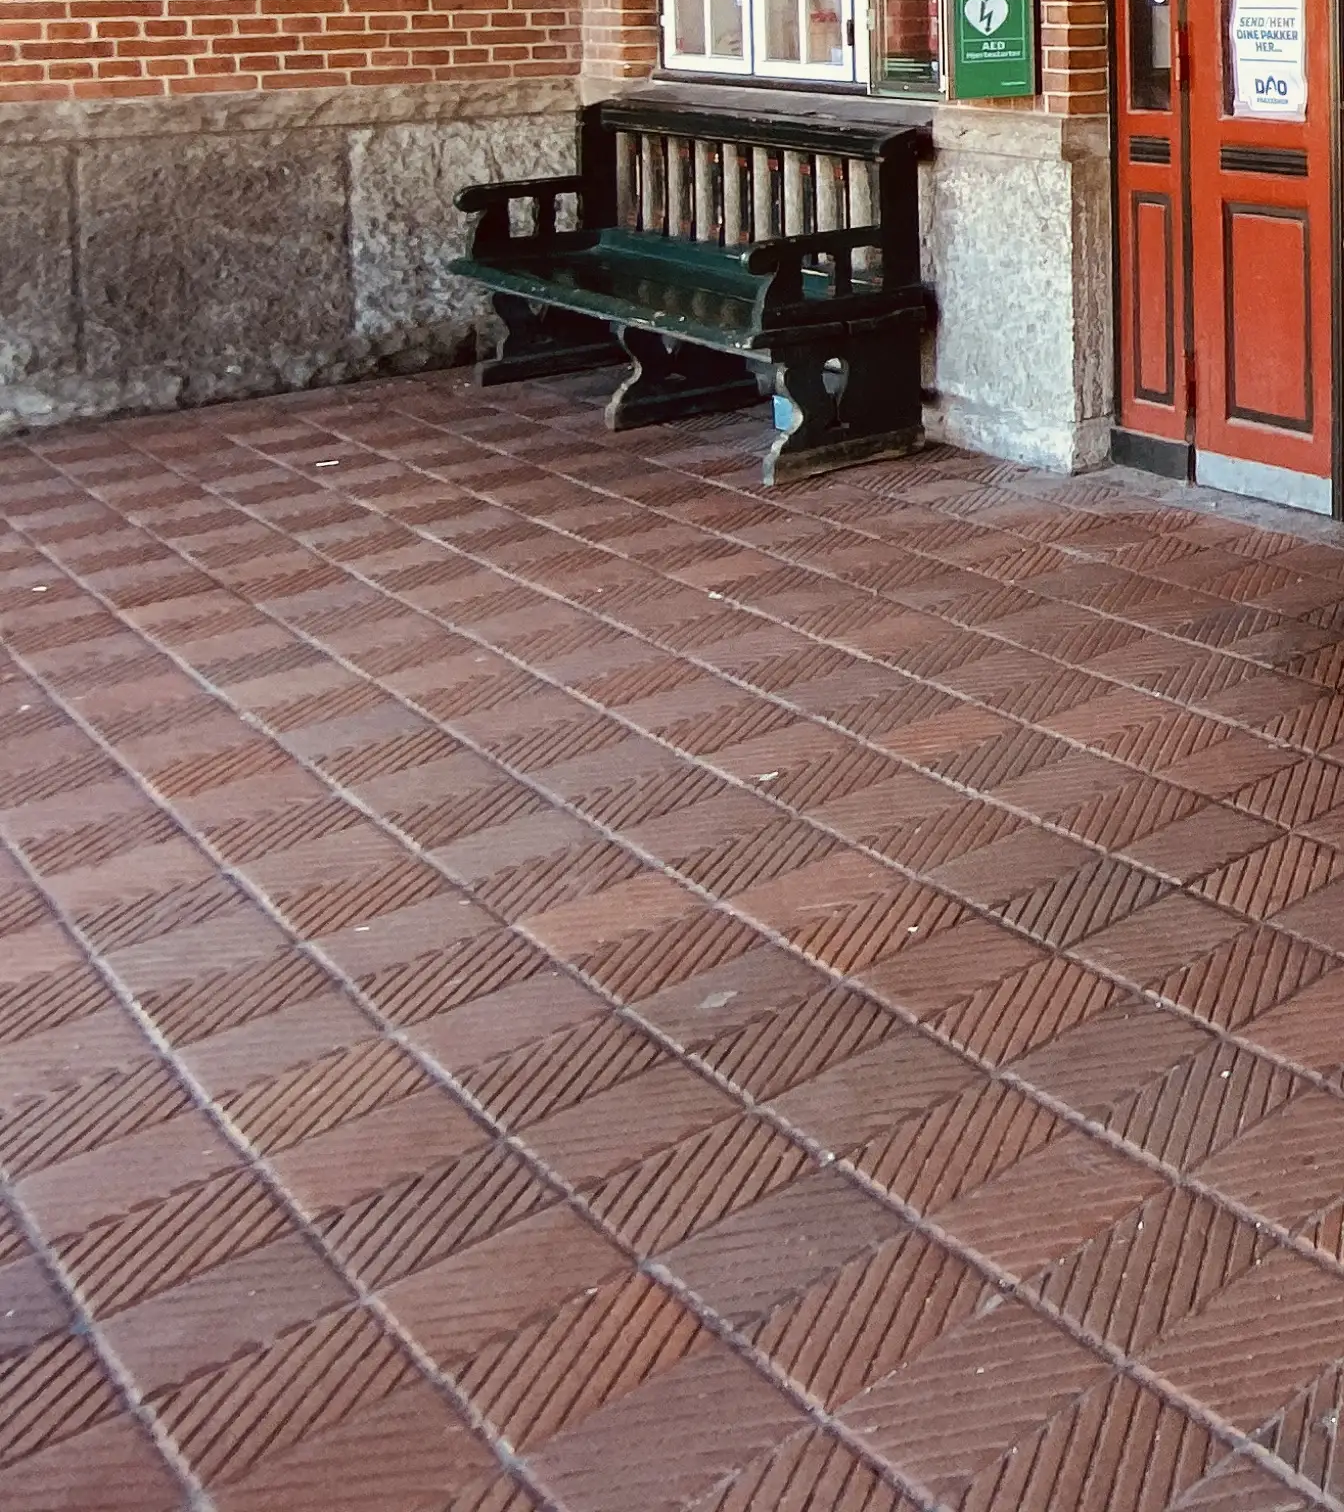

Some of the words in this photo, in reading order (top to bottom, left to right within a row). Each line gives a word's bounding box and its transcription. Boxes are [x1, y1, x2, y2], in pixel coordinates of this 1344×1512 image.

[1236, 29, 1259, 40] DINE
[1260, 29, 1299, 41] PAKKER
[982, 40, 1006, 51] AED
[1254, 75, 1288, 96] DAO
